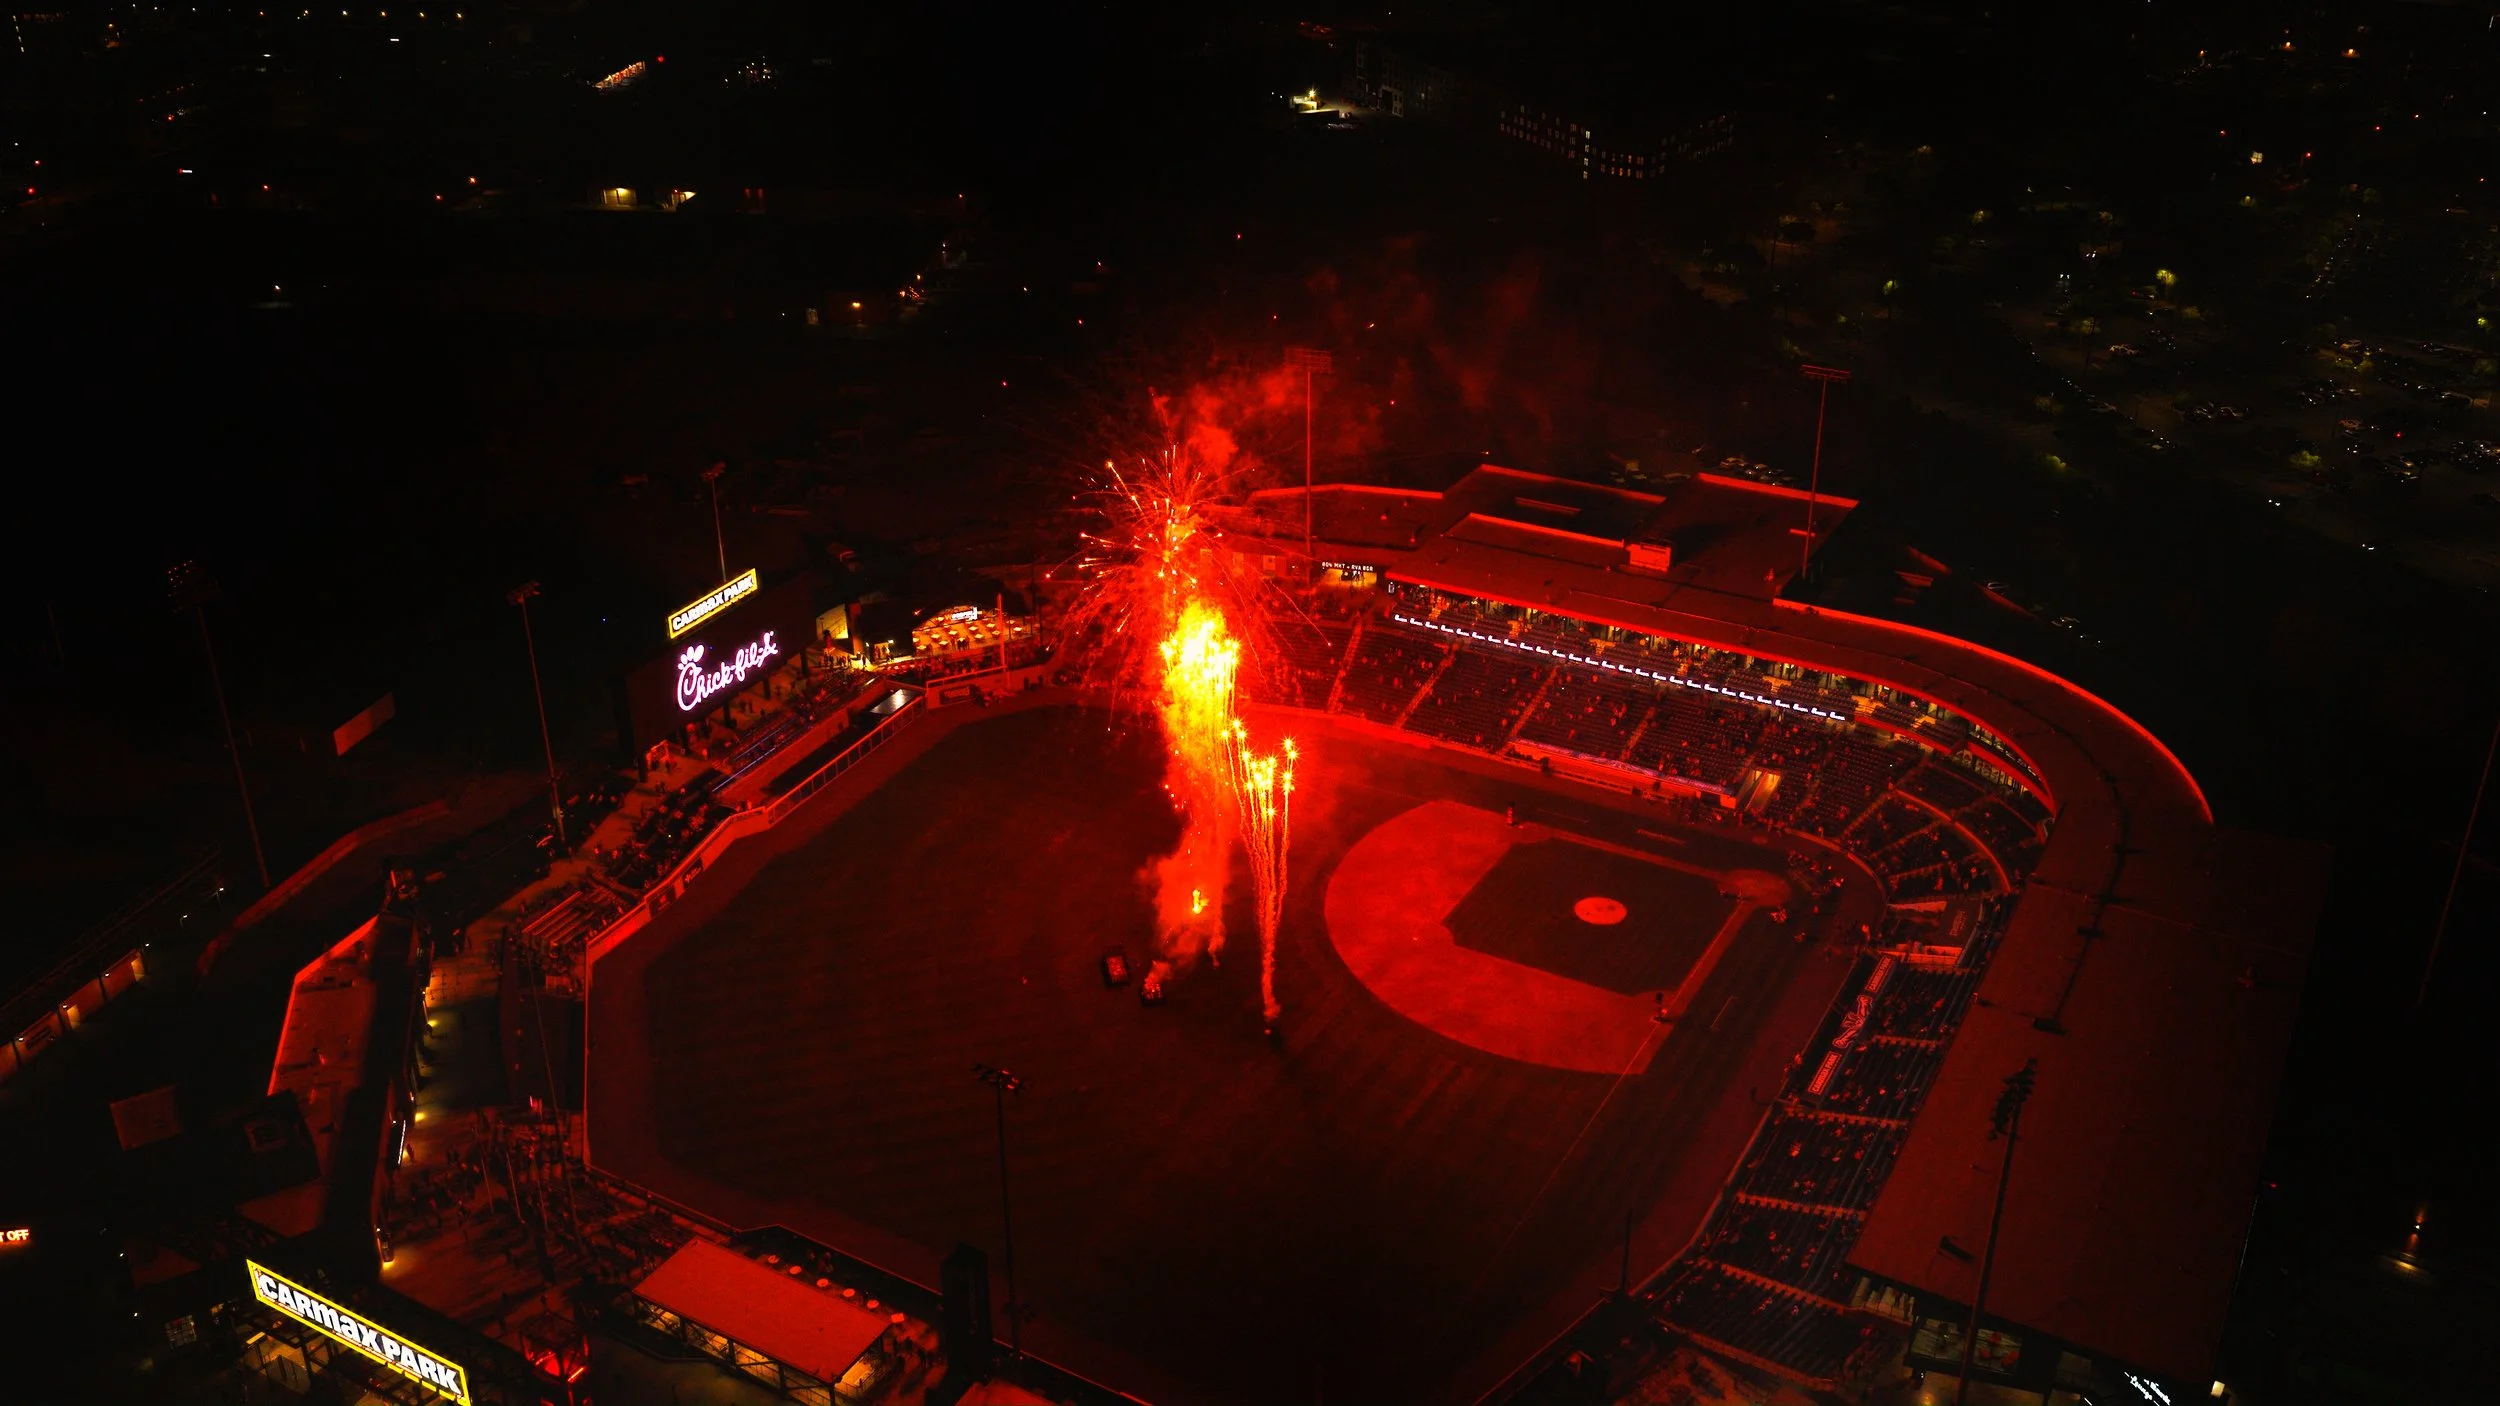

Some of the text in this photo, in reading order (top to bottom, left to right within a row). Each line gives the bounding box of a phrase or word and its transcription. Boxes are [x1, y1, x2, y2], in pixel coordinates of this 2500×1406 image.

[723, 575, 754, 602] PARK
[677, 631, 778, 711] Chick-fil-A
[6, 1229, 30, 1241] OFF
[380, 1335, 462, 1395] PARK
